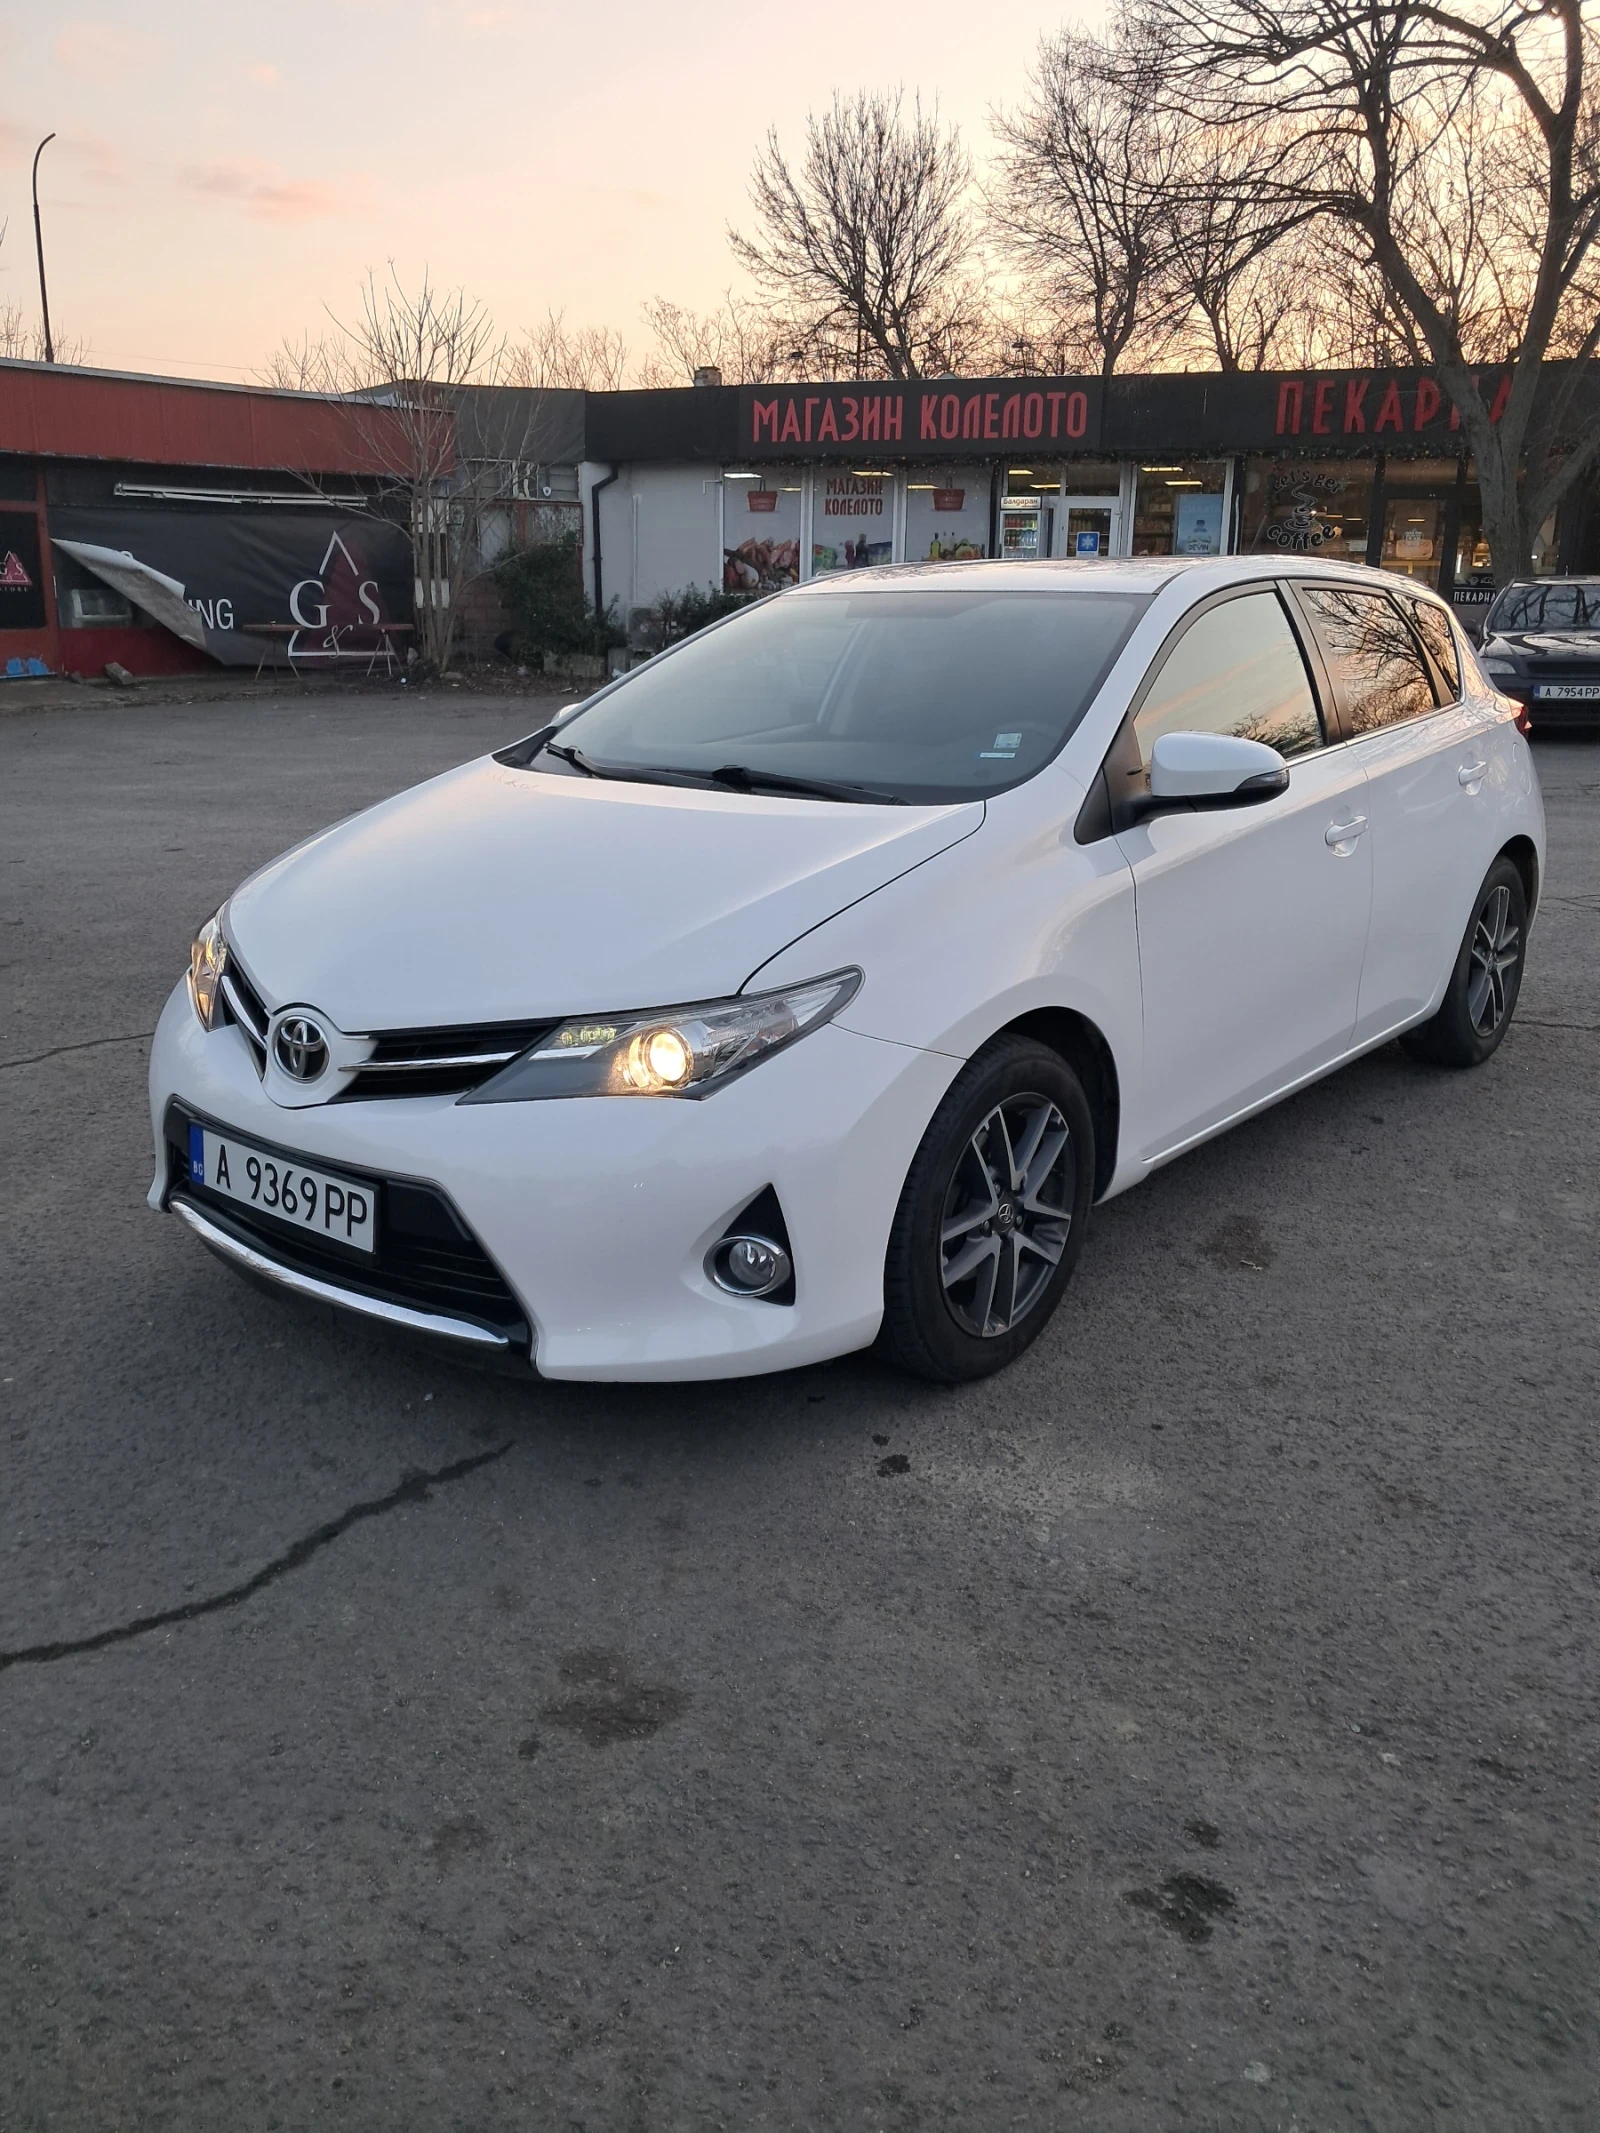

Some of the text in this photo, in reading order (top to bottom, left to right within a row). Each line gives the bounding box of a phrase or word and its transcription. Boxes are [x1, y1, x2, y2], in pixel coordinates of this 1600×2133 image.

[753, 391, 1087, 442] МАГАЗИН КОЛЕЛОТО
[826, 478, 883, 495] МАГАЗИН
[824, 498, 883, 515] КОЛЕЛОТО
[1545, 687, 1600, 697] A 7954 PP
[193, 1160, 204, 1176] BG
[216, 1144, 367, 1237] A 9369 PP
